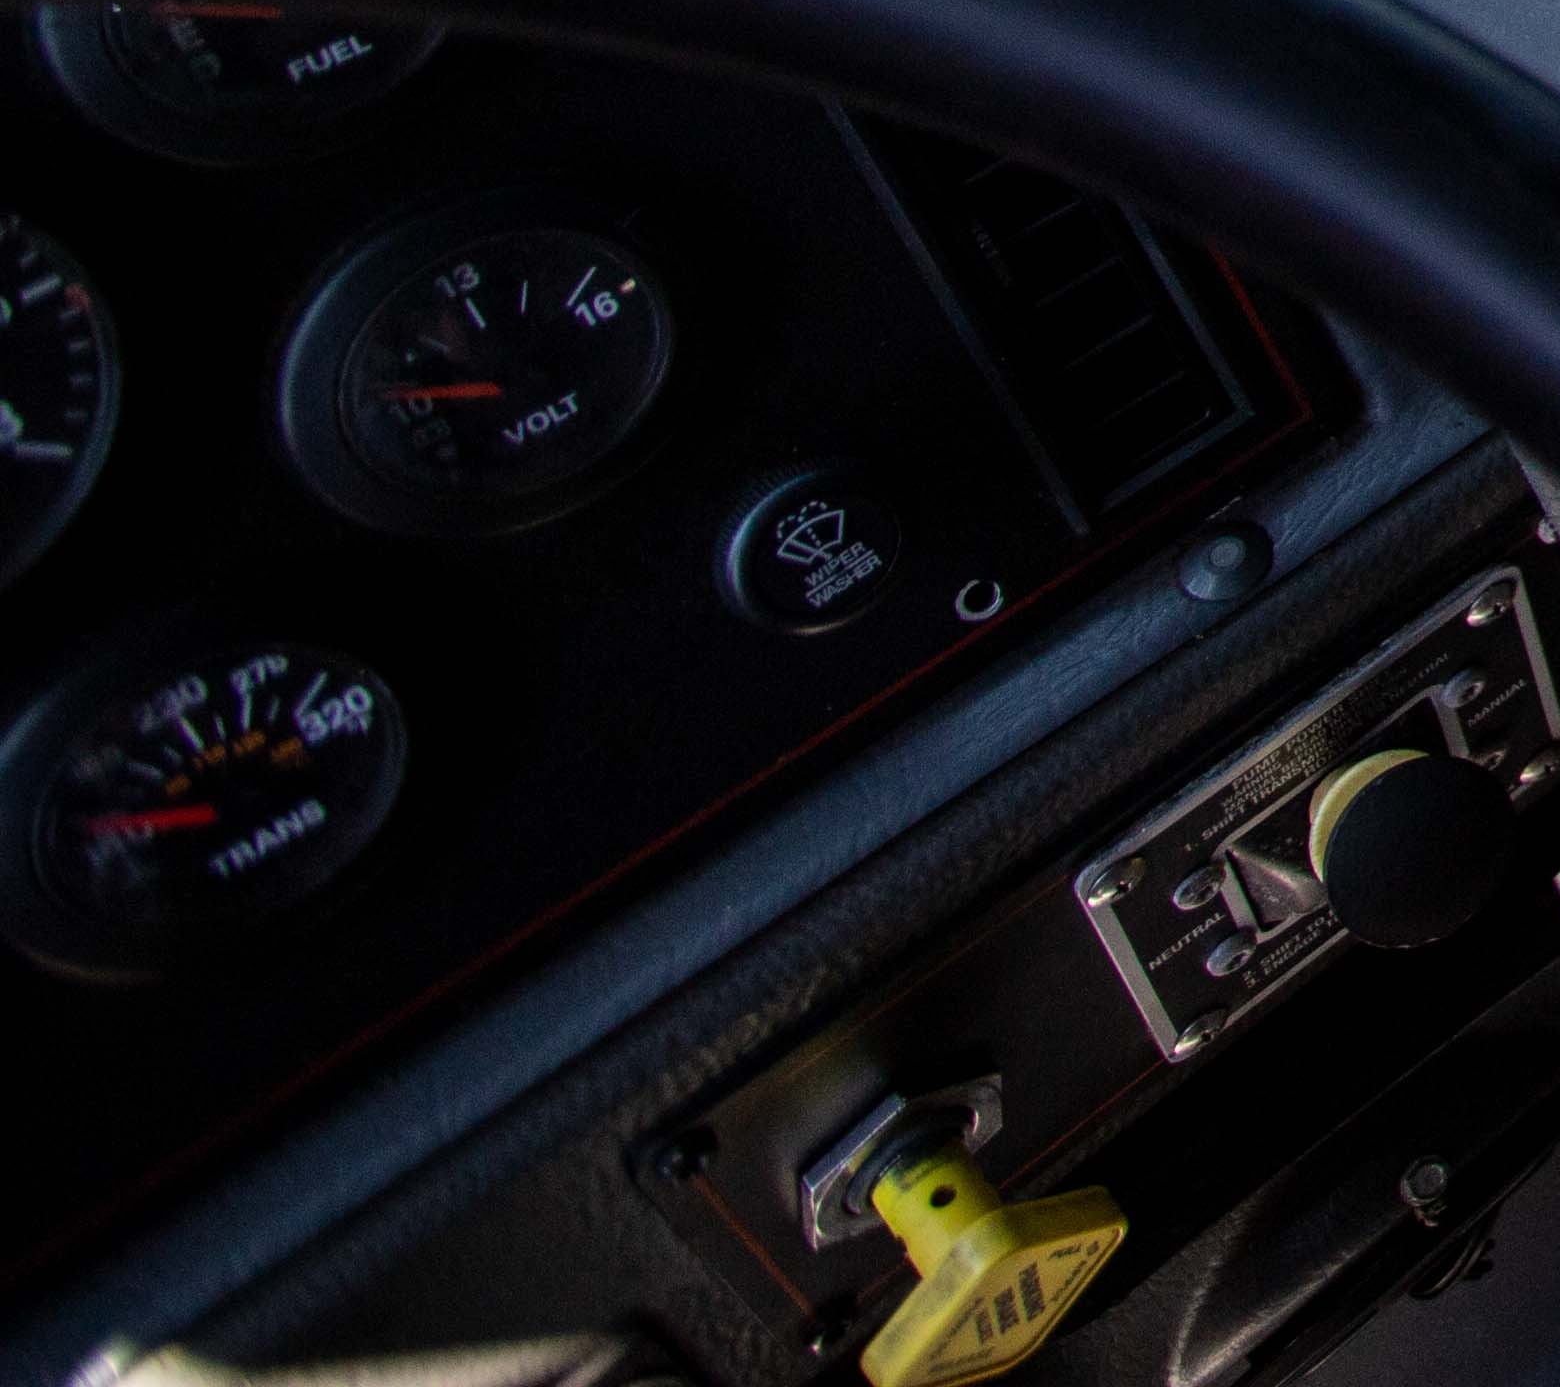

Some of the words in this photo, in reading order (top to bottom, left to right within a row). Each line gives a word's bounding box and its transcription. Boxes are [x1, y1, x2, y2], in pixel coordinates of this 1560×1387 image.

[285, 33, 374, 84] FUEL
[574, 290, 621, 328] 16
[502, 390, 581, 446] VOLT
[804, 542, 868, 587] WIPER
[807, 556, 883, 609] WASHER
[300, 684, 374, 746] 320
[1467, 678, 1526, 728] MANUAL
[1232, 750, 1281, 790] PUMP
[208, 798, 328, 880] TRANS
[1201, 808, 1246, 841] SHIFT
[1148, 912, 1226, 971] NEUTRAL
